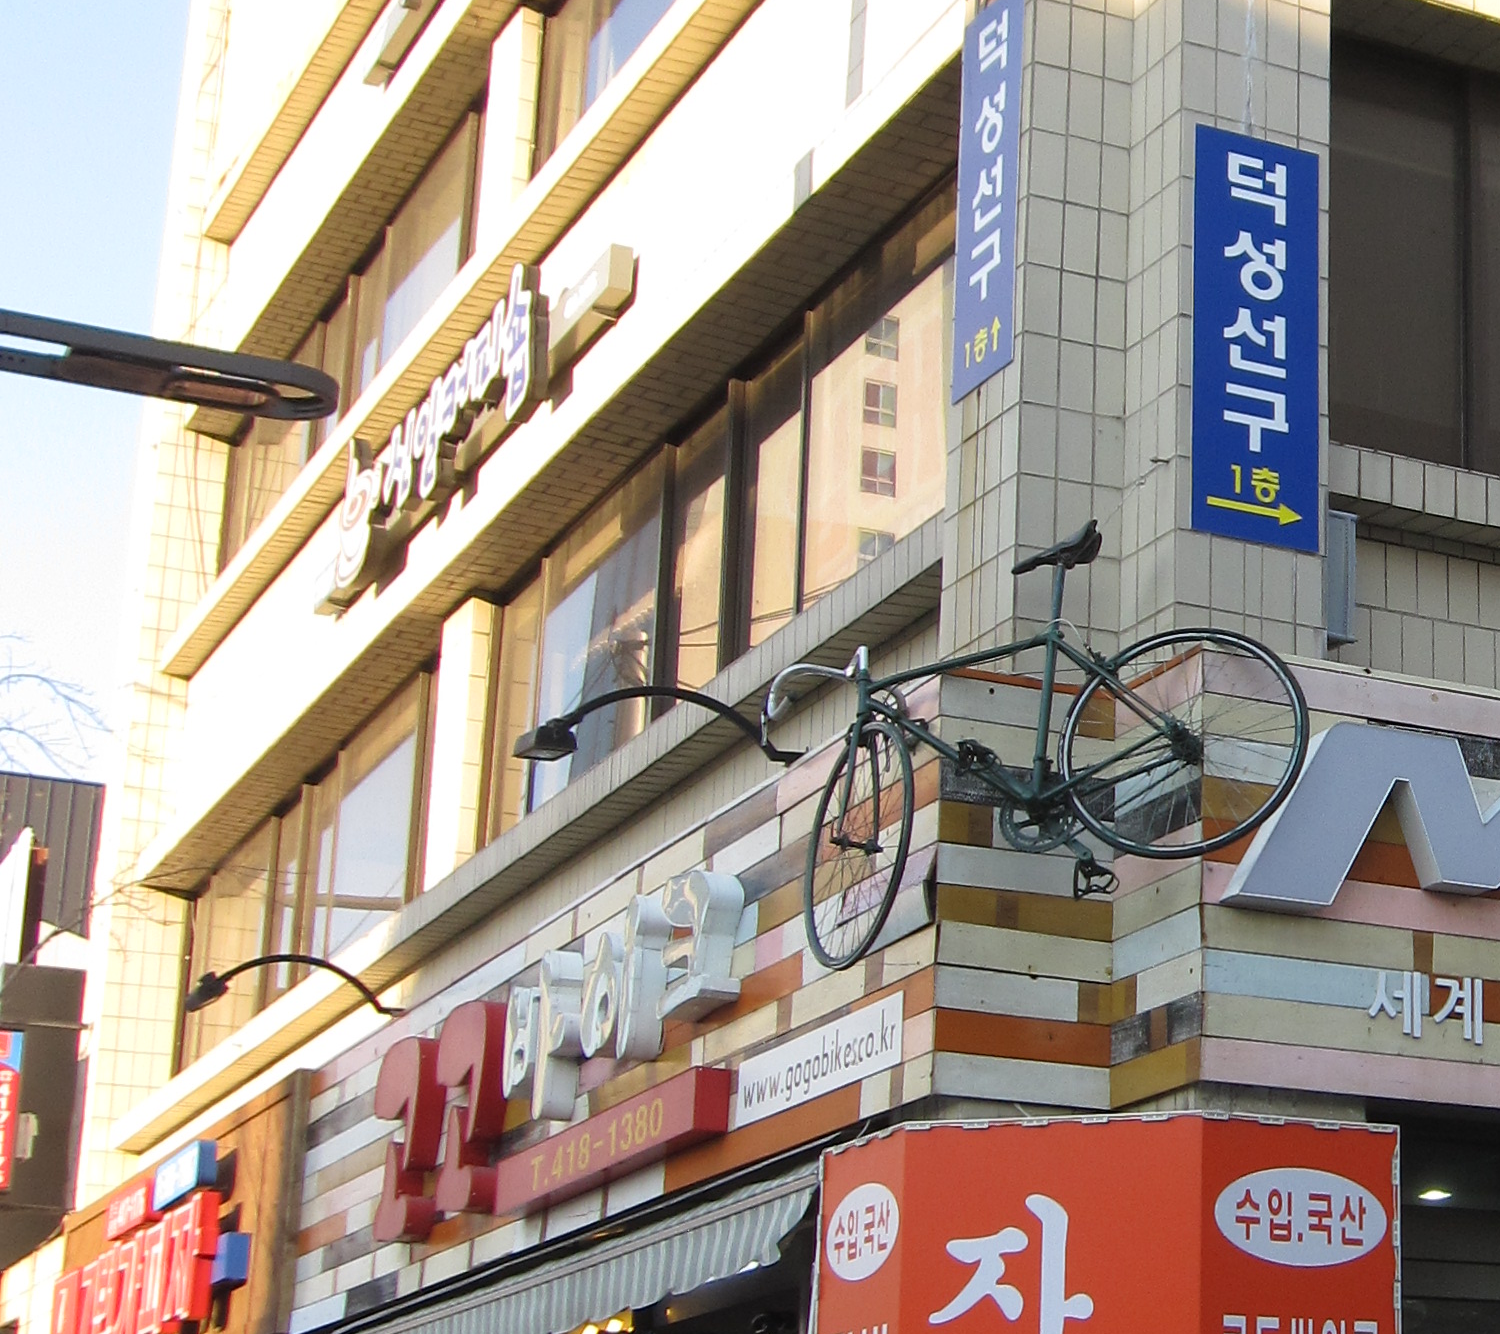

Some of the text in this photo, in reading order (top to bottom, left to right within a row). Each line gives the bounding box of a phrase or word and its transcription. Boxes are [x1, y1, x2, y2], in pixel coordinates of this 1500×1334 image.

[968, 8, 1010, 302] 덕성선구
[1222, 150, 1290, 453] 덕성선구
[1230, 463, 1282, 504] 1층
[1367, 969, 1484, 1046] 세계
[530, 1097, 664, 1193] T.418-1380
